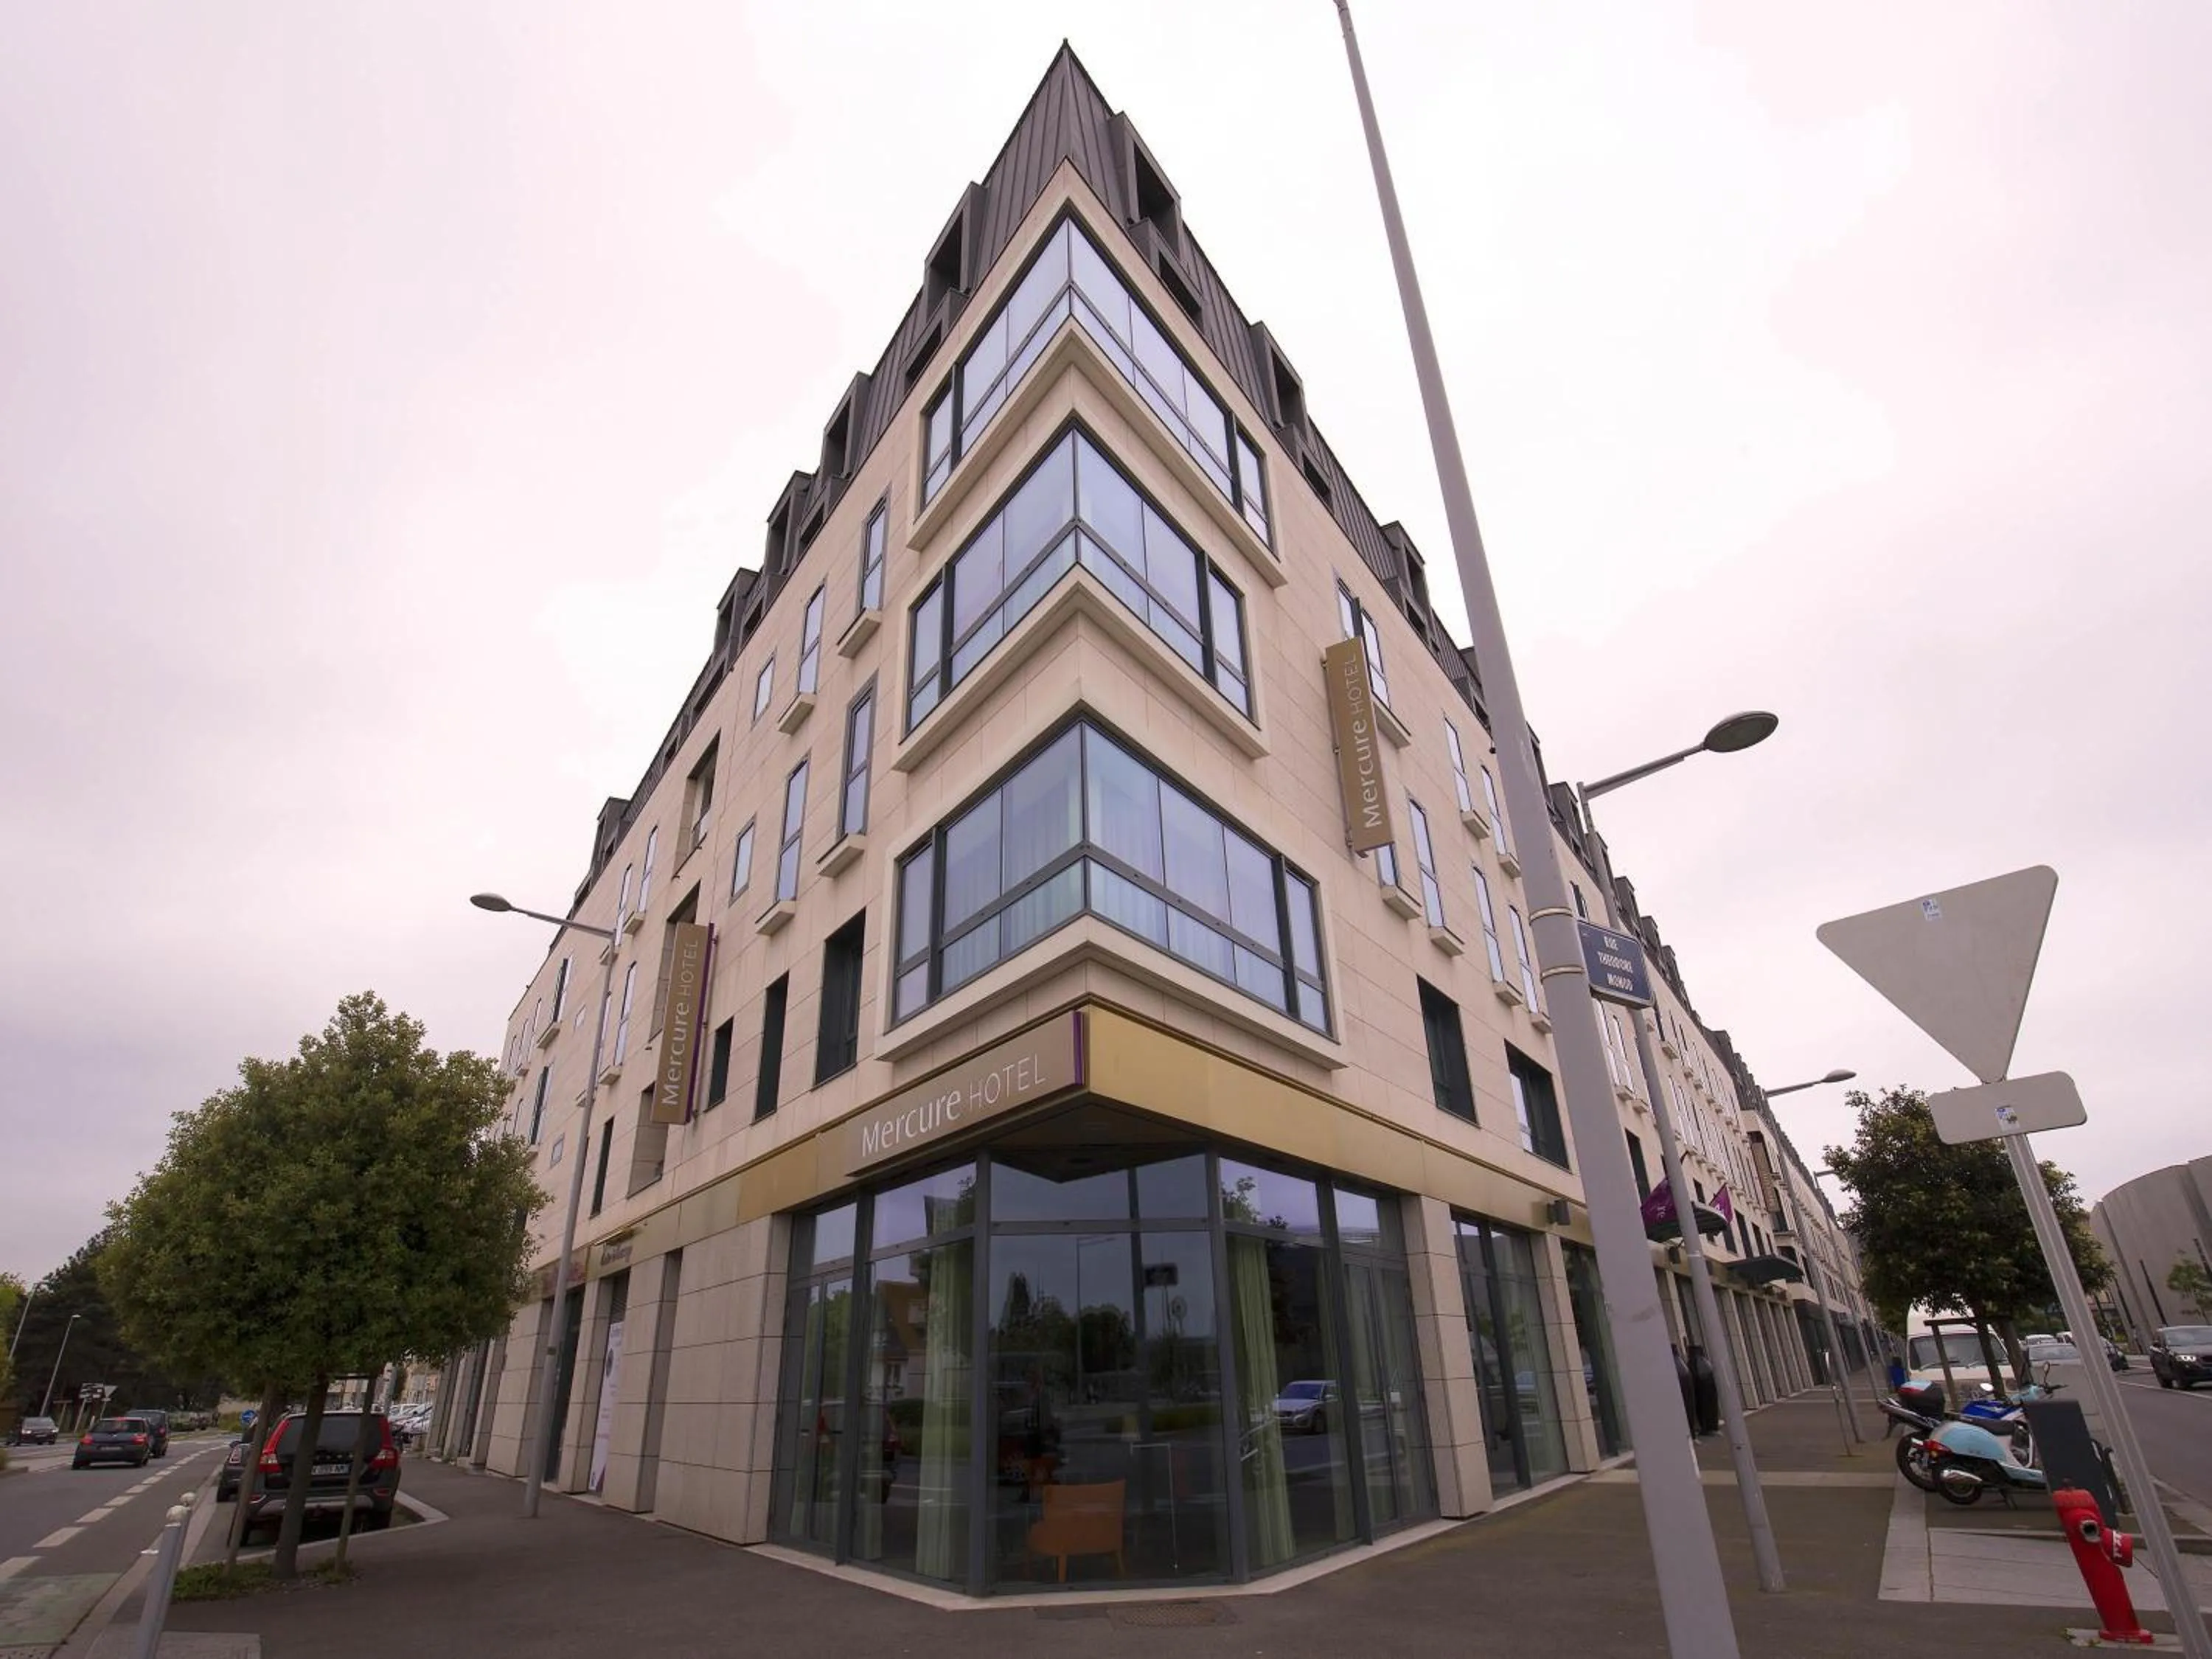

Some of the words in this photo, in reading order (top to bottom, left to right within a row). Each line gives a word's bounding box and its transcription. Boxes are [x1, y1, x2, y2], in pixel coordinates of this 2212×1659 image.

[1344, 653, 1367, 717] HOTEL
[1352, 719, 1382, 829] Mercure
[661, 1002, 689, 1106] Mercure
[678, 940, 699, 998] HOTEL
[861, 1090, 961, 1157] Mercure
[969, 1053, 1046, 1111] HOTEL
